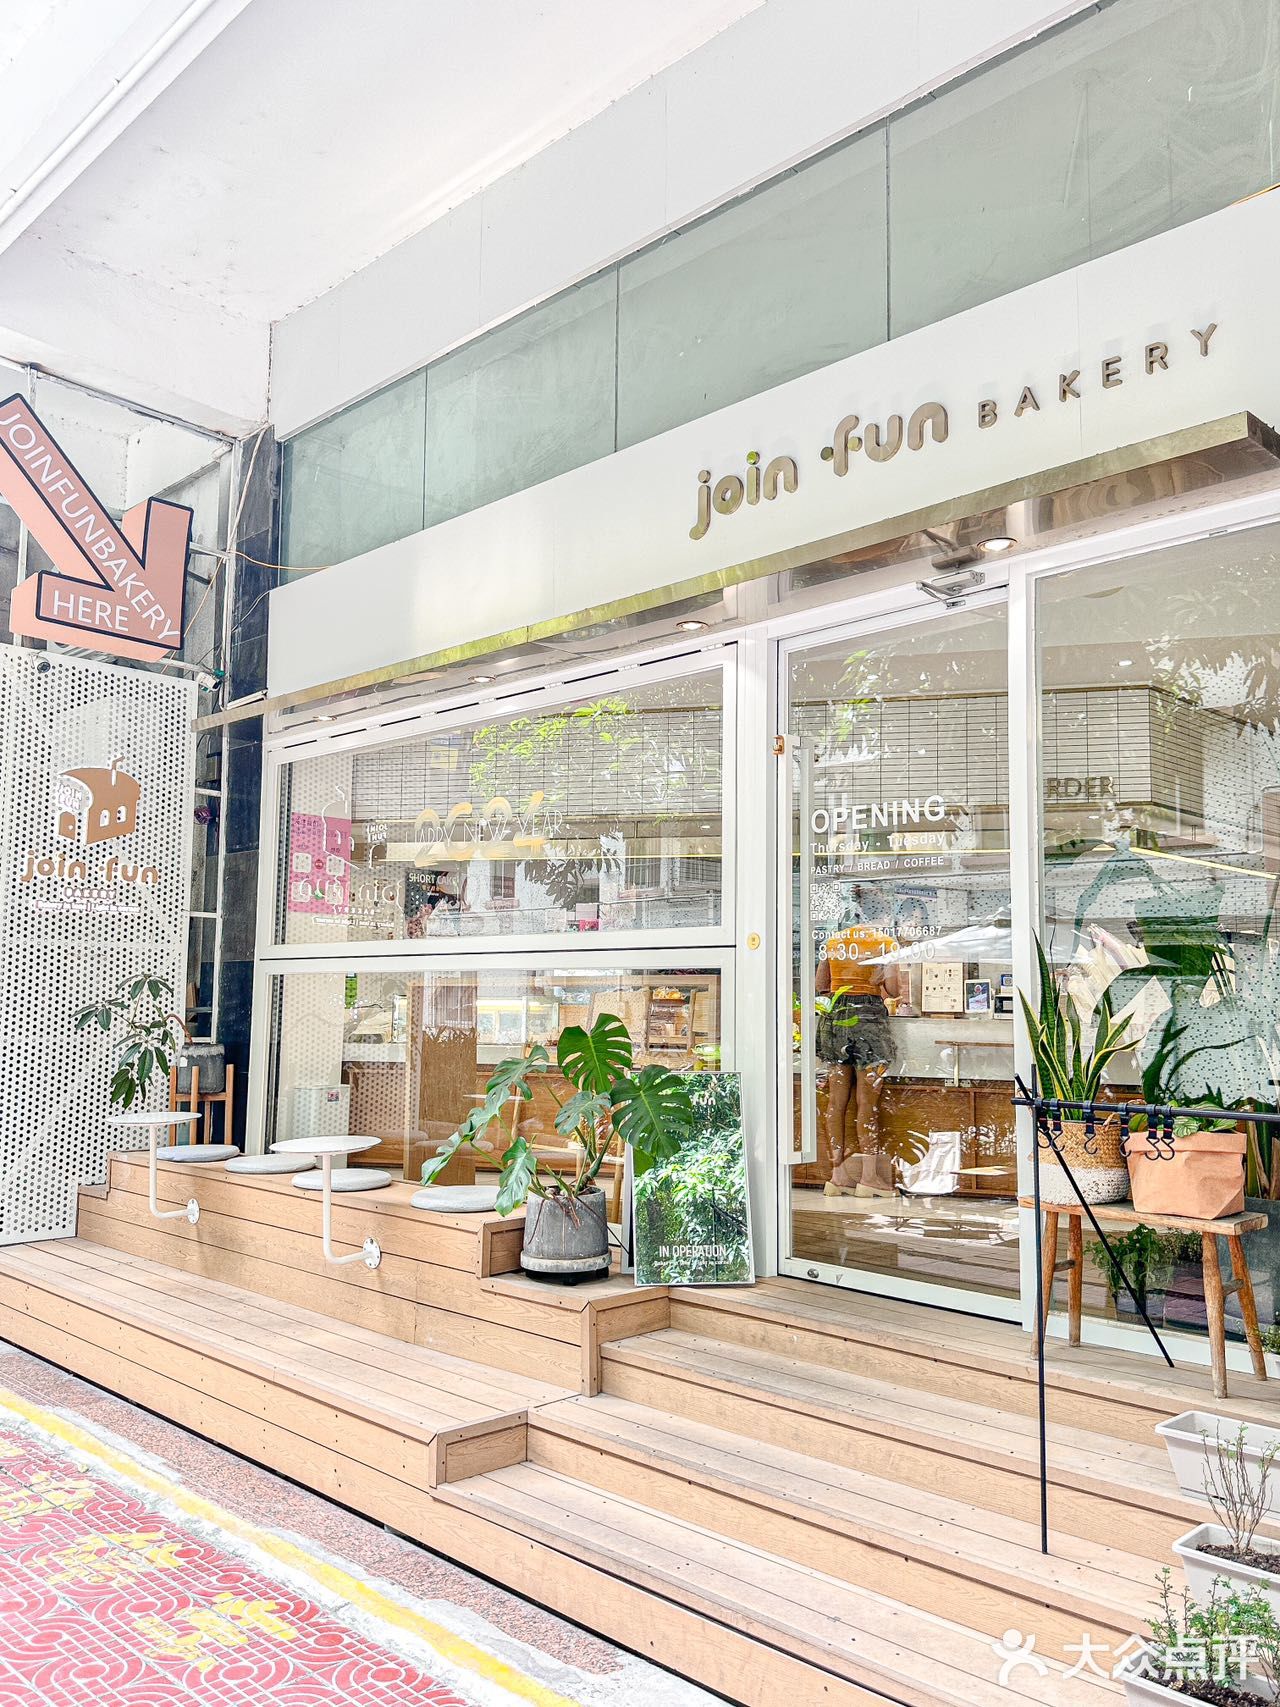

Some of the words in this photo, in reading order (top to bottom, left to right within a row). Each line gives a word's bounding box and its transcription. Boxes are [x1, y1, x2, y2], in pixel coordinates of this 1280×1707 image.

[689, 450, 799, 541] join
[978, 322, 1218, 430] BAKERY
[0, 412, 181, 640] JOINFUNBAKERY
[53, 589, 130, 632] HERE
[1046, 775, 1116, 798] RDER
[516, 809, 563, 838] YEAR
[811, 794, 945, 834] OPENING
[810, 839, 870, 854] Thursday
[887, 832, 946, 848] Tuesday
[20, 850, 87, 883] join
[810, 863, 845, 875] PASTRY
[857, 859, 890, 871] BREAD
[904, 855, 945, 868] COFFEE
[408, 872, 436, 884] SHORT
[811, 929, 851, 940] Contact
[819, 942, 859, 961] 8:30
[659, 1245, 670, 1258] IN
[672, 1243, 727, 1258] OPERATION
